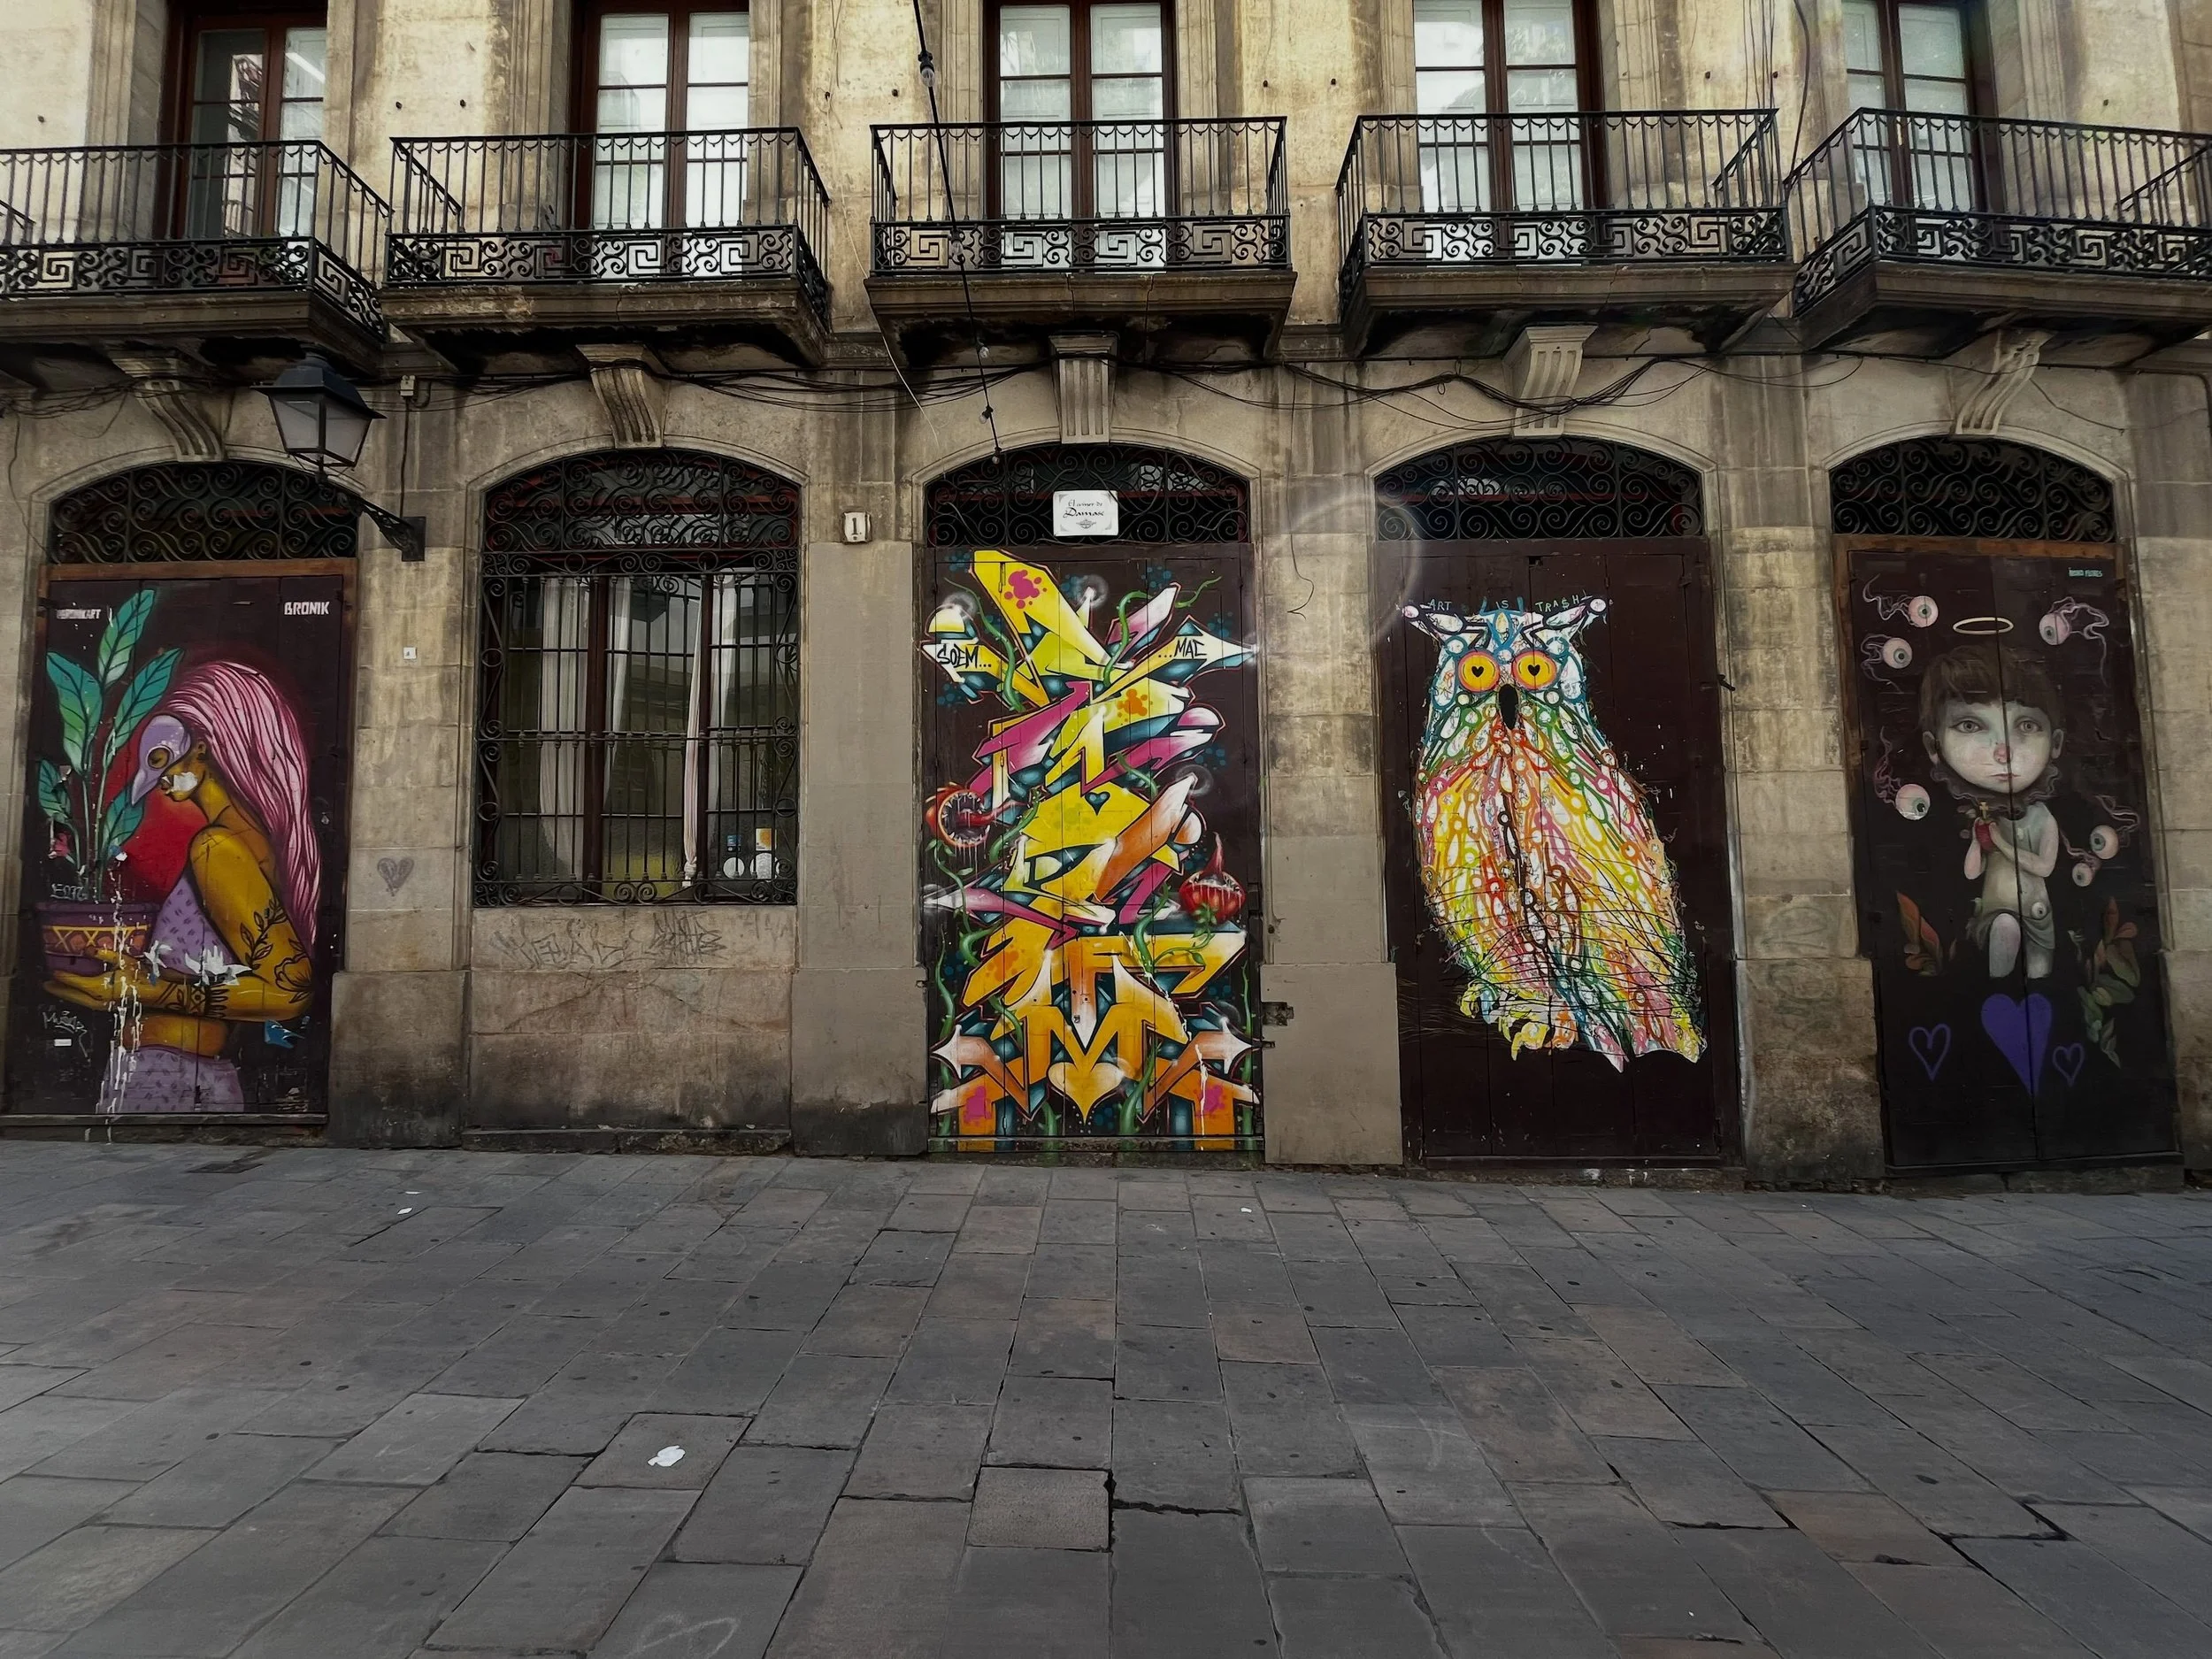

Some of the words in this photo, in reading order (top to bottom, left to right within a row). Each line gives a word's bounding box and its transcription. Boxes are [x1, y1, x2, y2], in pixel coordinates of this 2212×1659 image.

[284, 601, 330, 615] BRONIK
[1428, 598, 1452, 611] ART
[1495, 600, 1509, 611] IS
